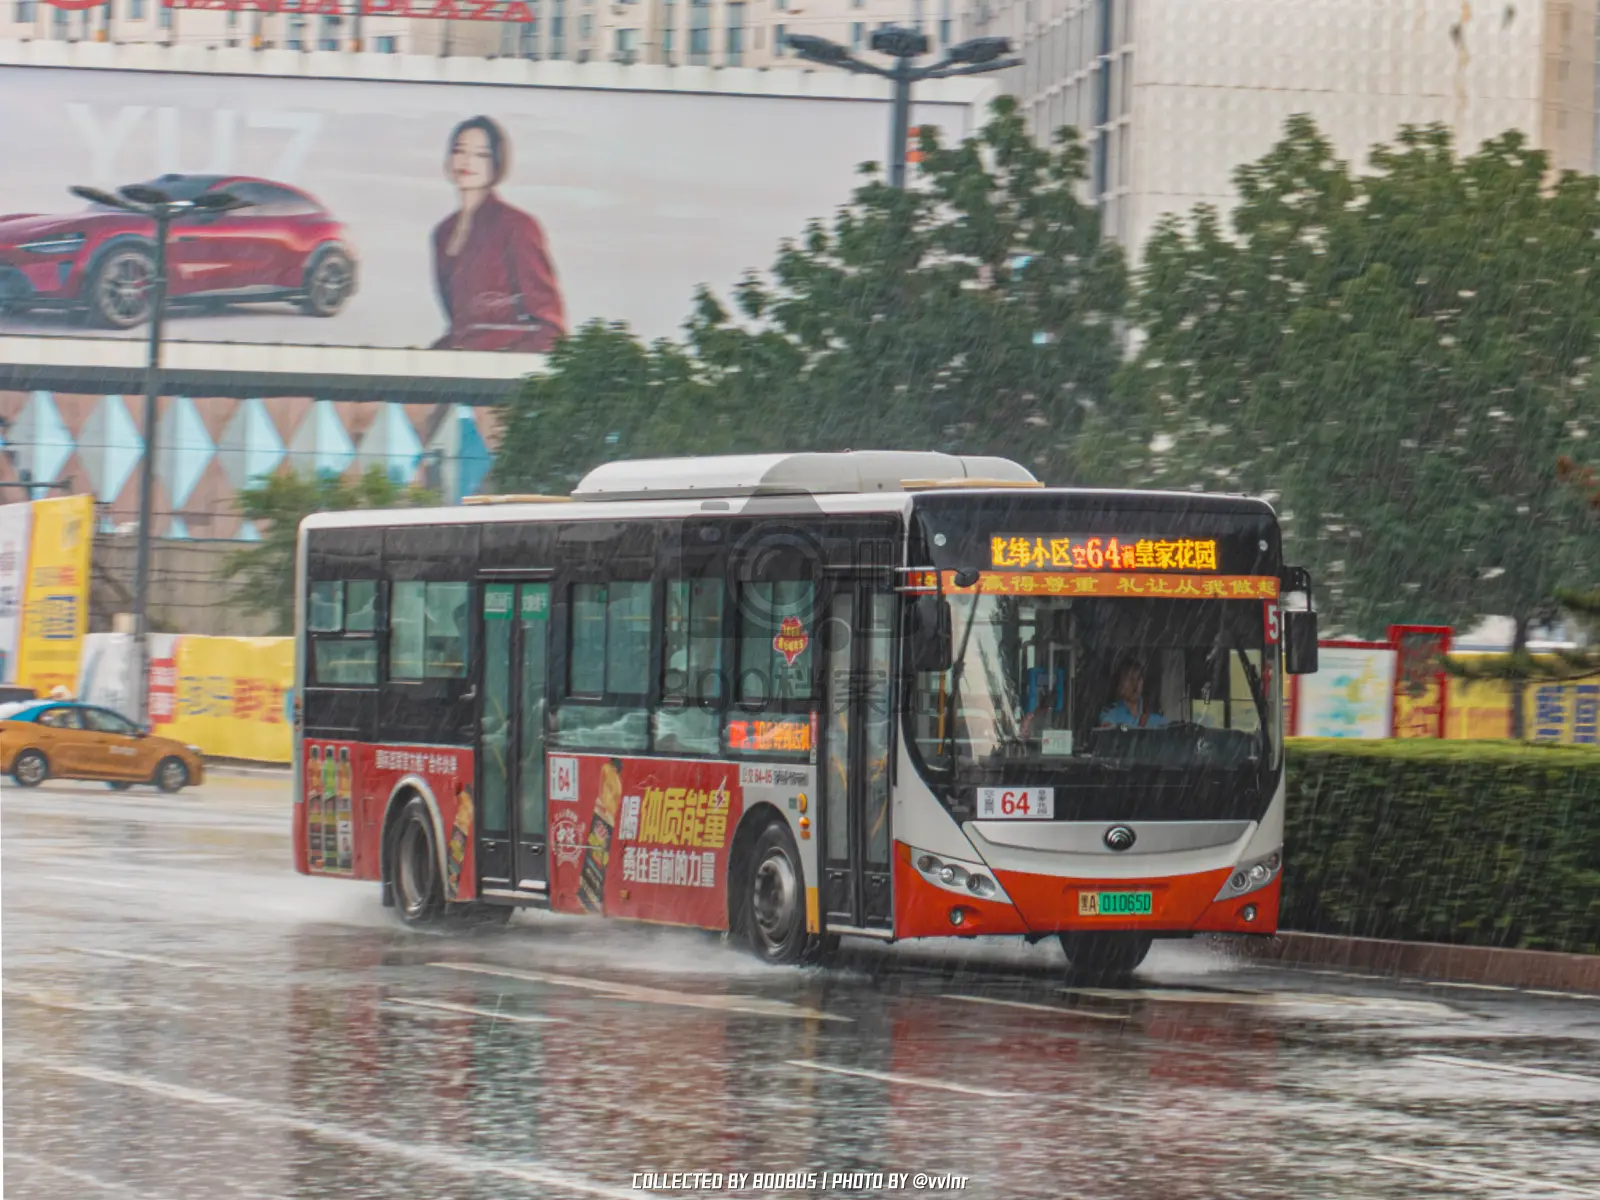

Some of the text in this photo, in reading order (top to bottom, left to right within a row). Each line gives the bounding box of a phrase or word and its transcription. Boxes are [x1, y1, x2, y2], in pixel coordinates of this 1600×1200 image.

[64, 101, 323, 186] YU7
[1001, 790, 1031, 815] 64
[622, 846, 716, 888] 勇往直前的力量
